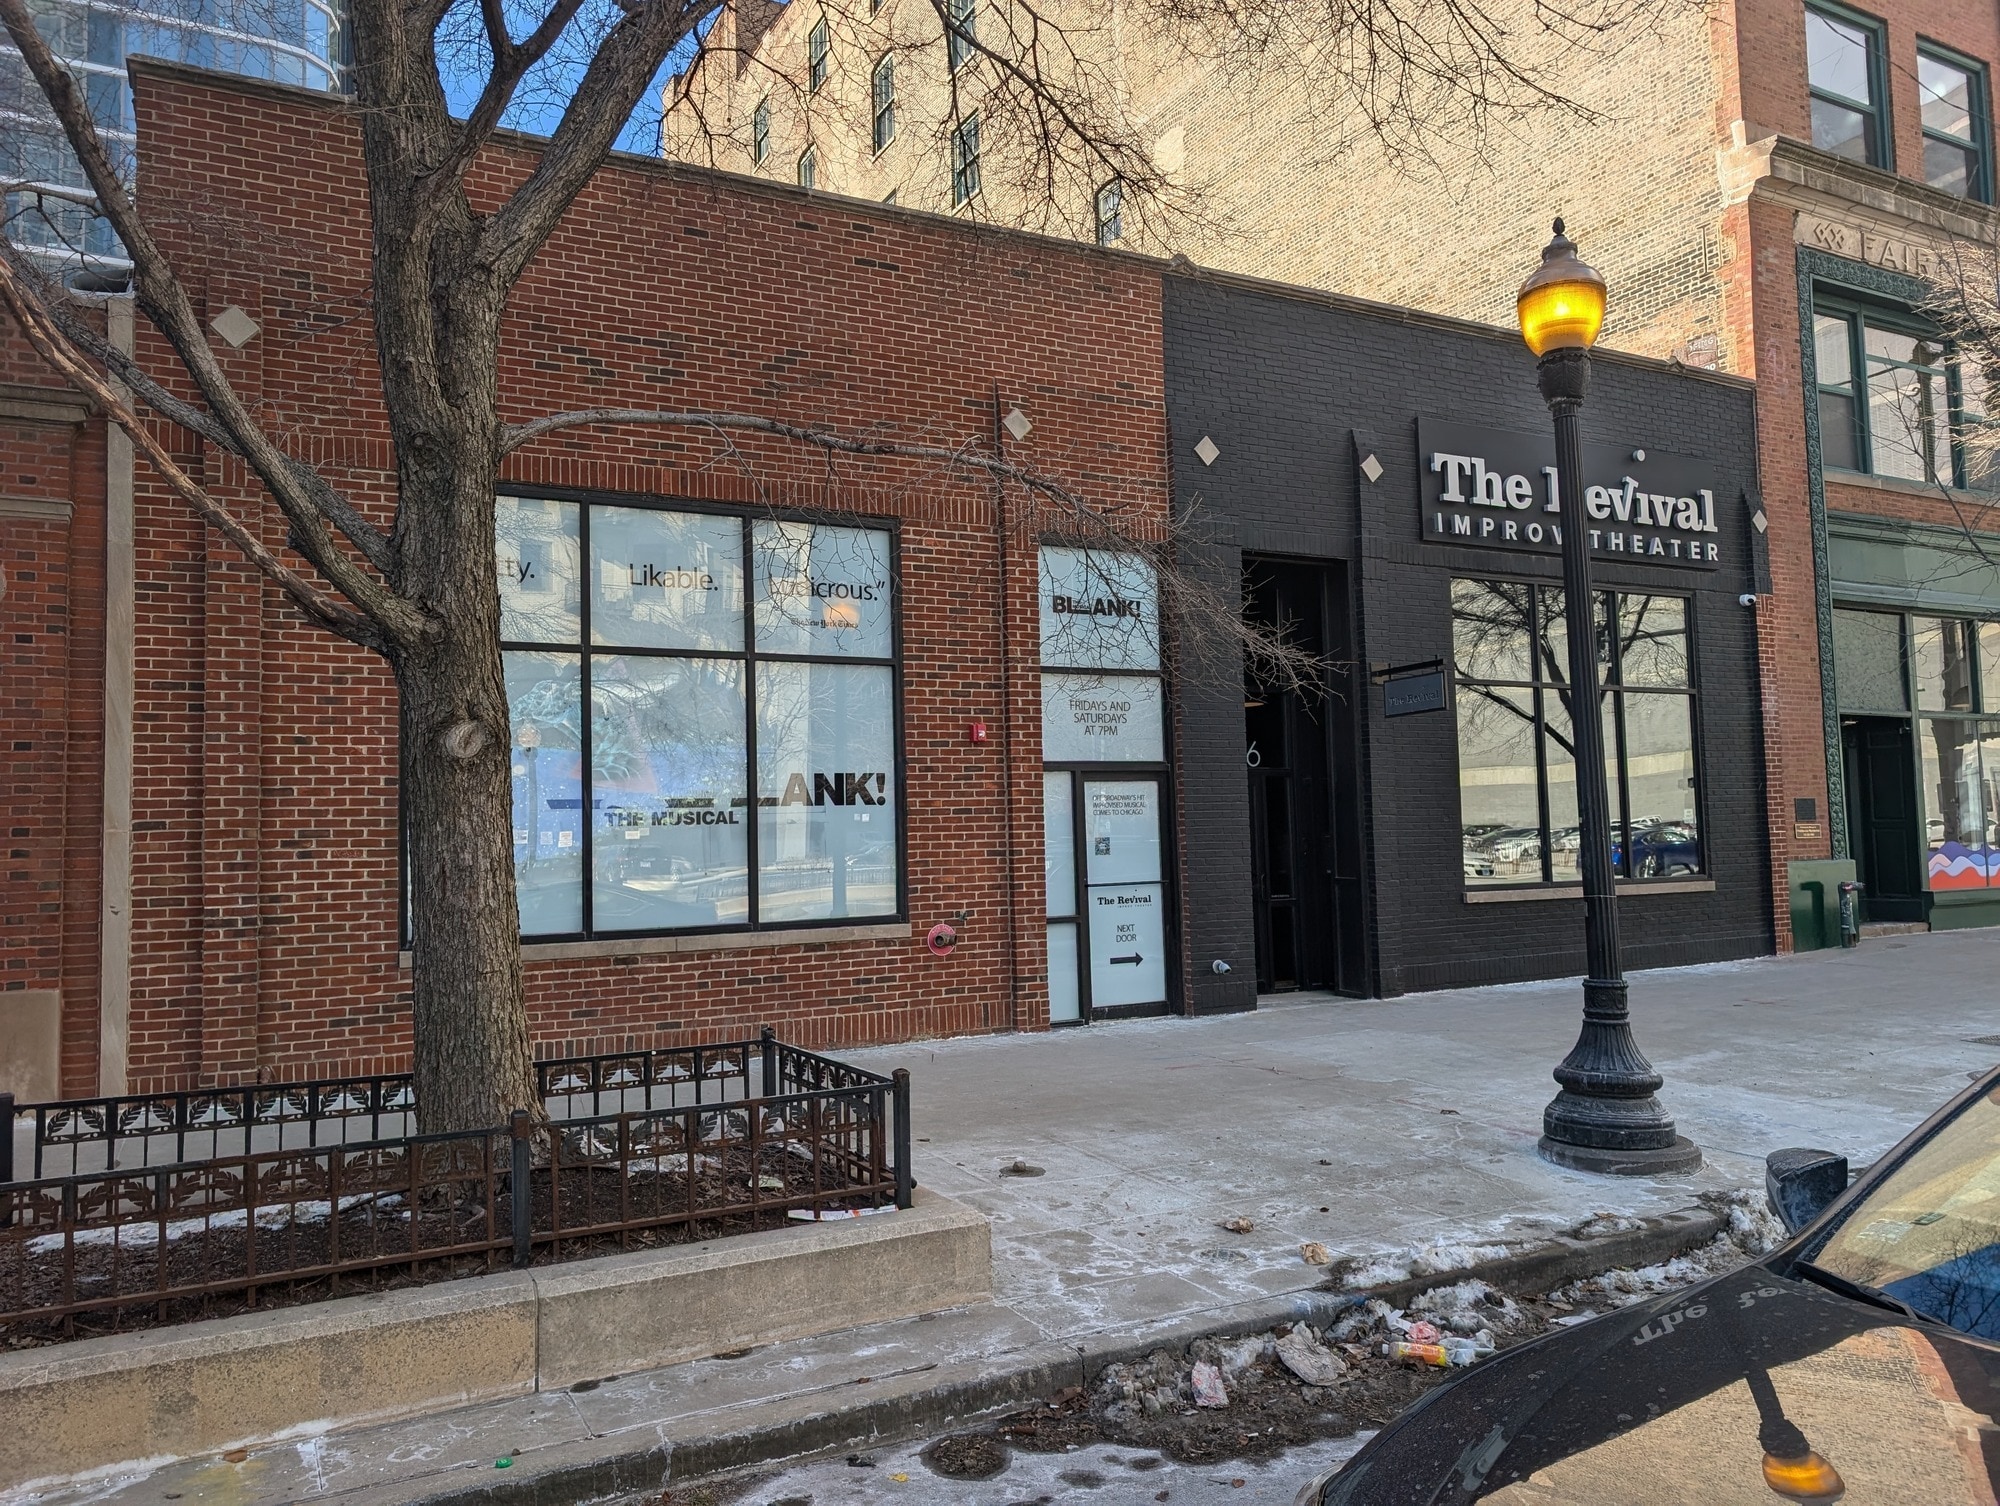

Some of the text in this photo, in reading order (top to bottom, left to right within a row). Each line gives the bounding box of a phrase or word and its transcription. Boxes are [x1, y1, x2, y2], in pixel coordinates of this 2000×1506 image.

[1430, 452, 1533, 510] The
[1588, 529, 1720, 562] THEATER
[628, 562, 720, 592] Likable.
[1069, 699, 1131, 712] FRIDAYS AND
[1073, 712, 1128, 724] SATURDAYS
[1084, 725, 1119, 736] AT 7PM
[1246, 741, 1262, 768] 6
[603, 809, 741, 828] THE MUSICAL
[1120, 808, 1144, 816] CHICAGO
[1096, 896, 1116, 906] The
[1117, 890, 1153, 905] Revival
[1116, 924, 1136, 933] NEXT
[1115, 933, 1138, 943] DOOR
